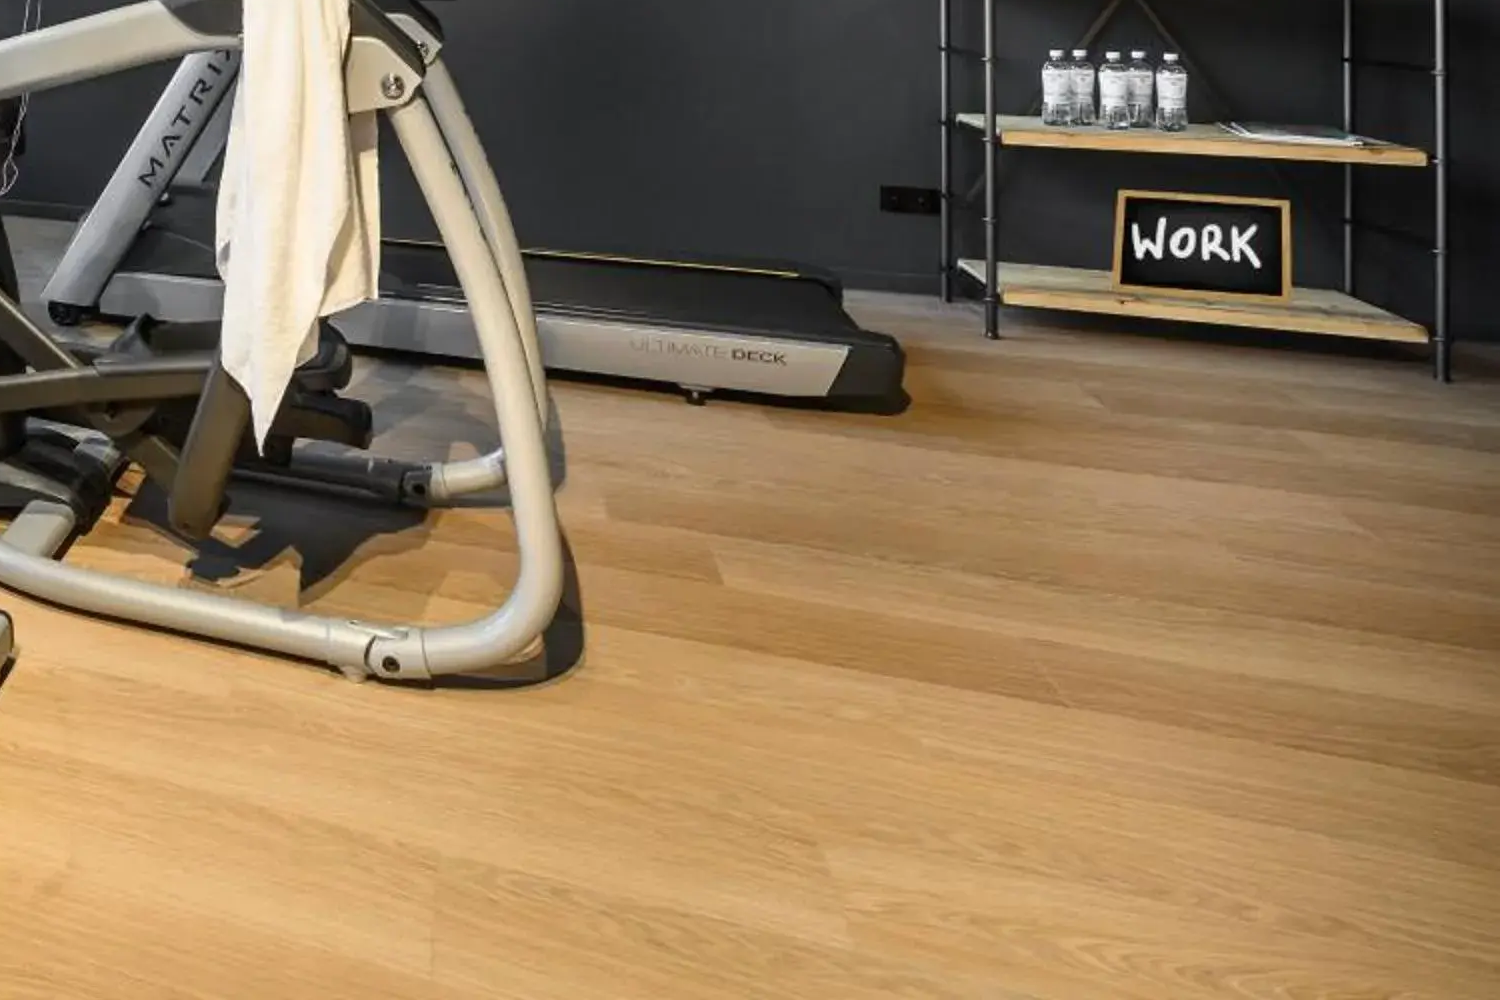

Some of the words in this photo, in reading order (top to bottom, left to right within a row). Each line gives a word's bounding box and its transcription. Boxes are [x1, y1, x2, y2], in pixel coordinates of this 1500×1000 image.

[1130, 216, 1263, 270] WORK
[629, 337, 726, 361] ULTIMATE
[731, 348, 789, 367] DECK
